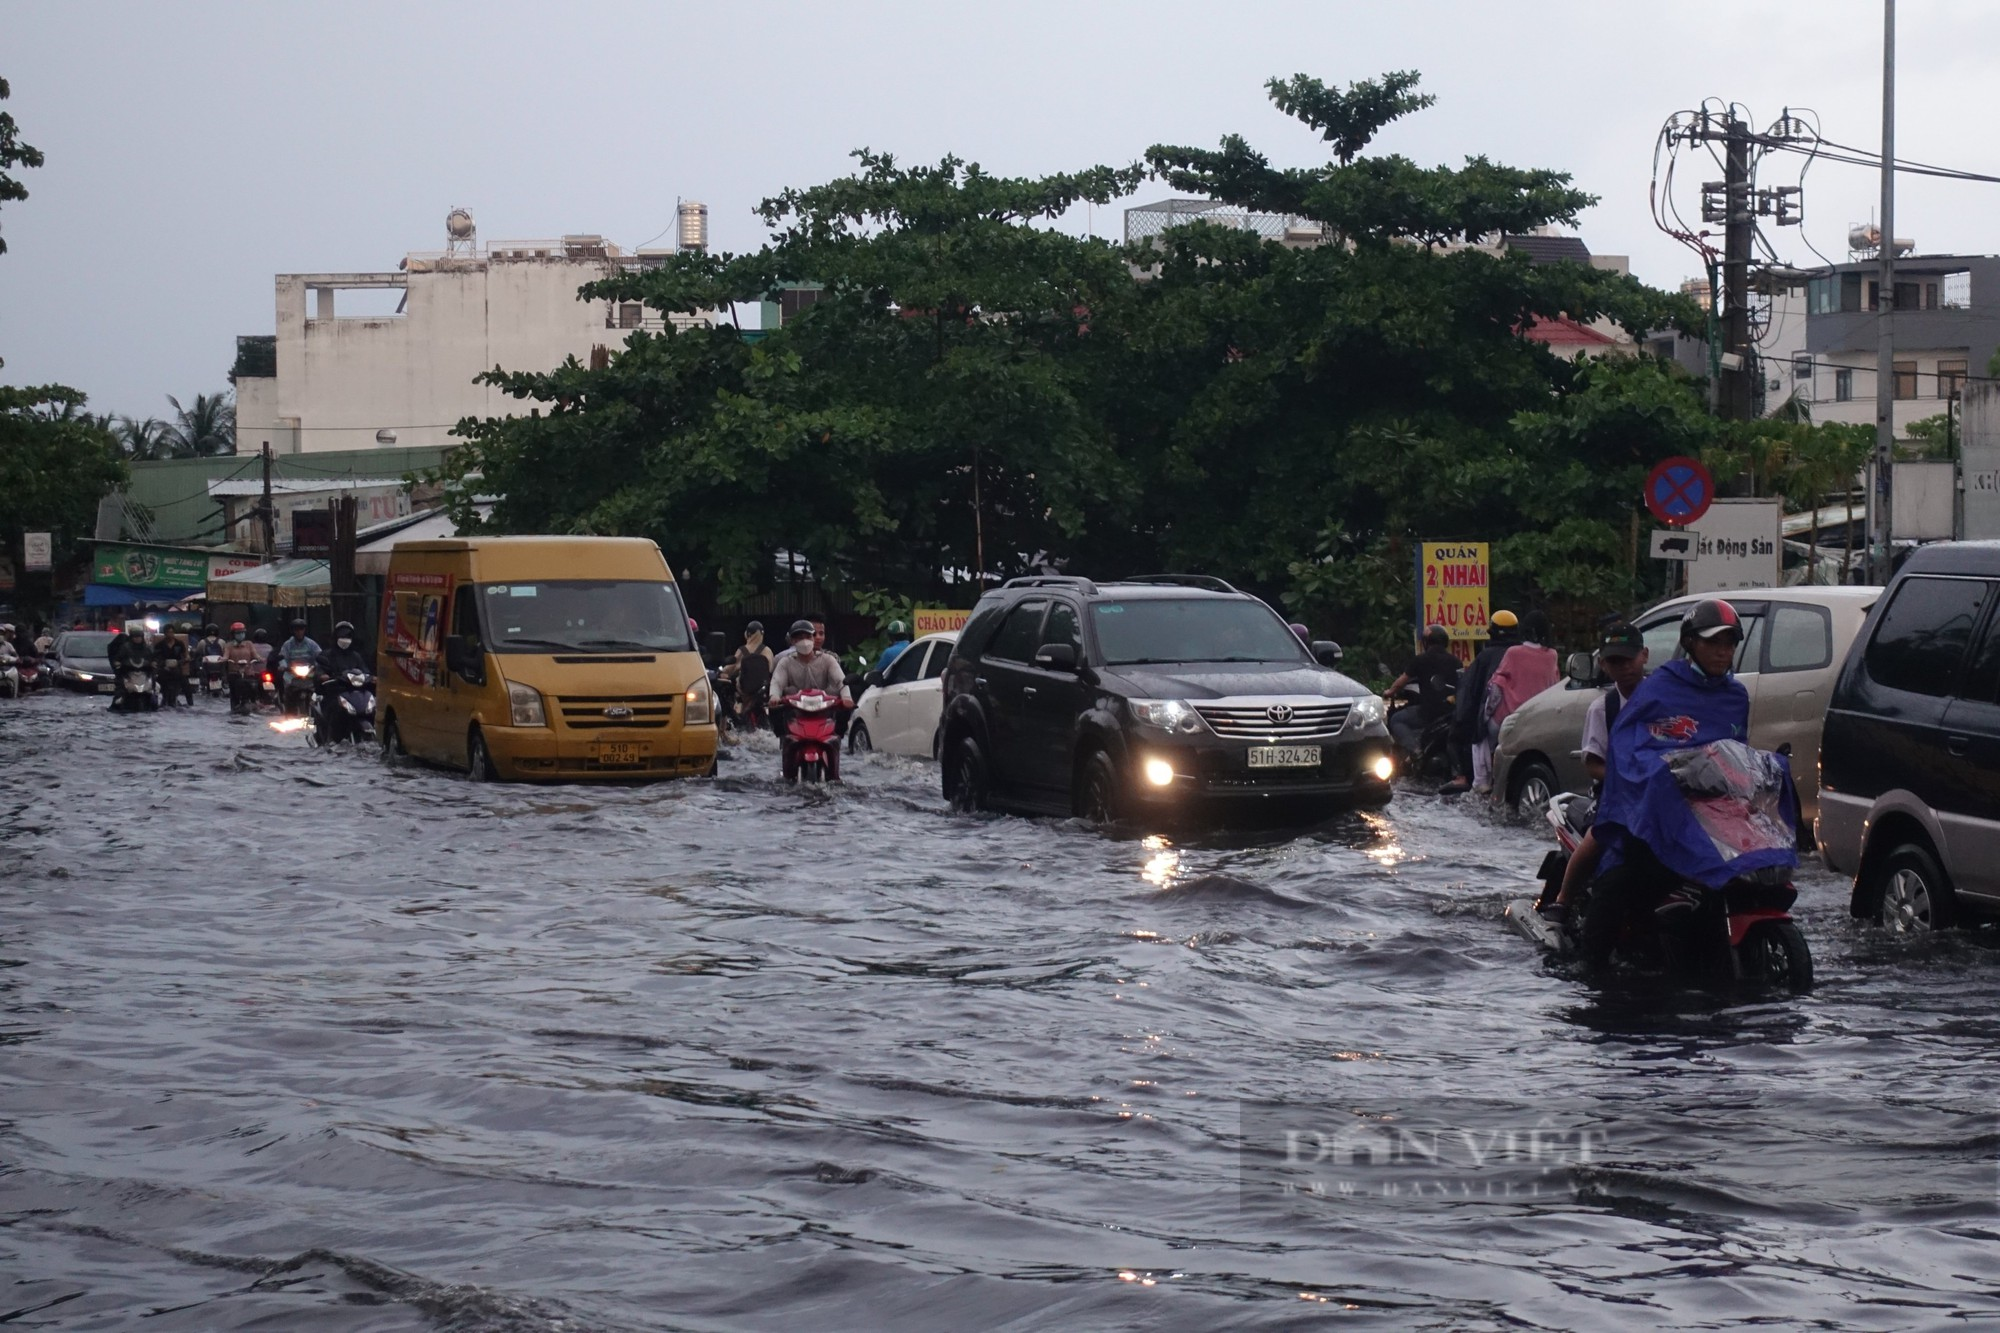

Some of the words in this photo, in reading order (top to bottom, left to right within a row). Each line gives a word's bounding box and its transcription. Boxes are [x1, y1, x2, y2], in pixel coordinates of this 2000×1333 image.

[1435, 545, 1477, 560] QUÁN
[1698, 536, 1712, 555] ất
[1717, 537, 1747, 561] Động
[1751, 536, 1773, 555] Sản
[1427, 564, 1438, 587] 2
[1426, 589, 1458, 627] LẨU
[1464, 596, 1487, 627] GÀ
[917, 612, 946, 632] CHÁO
[1250, 748, 1318, 764] 51H-324.26
